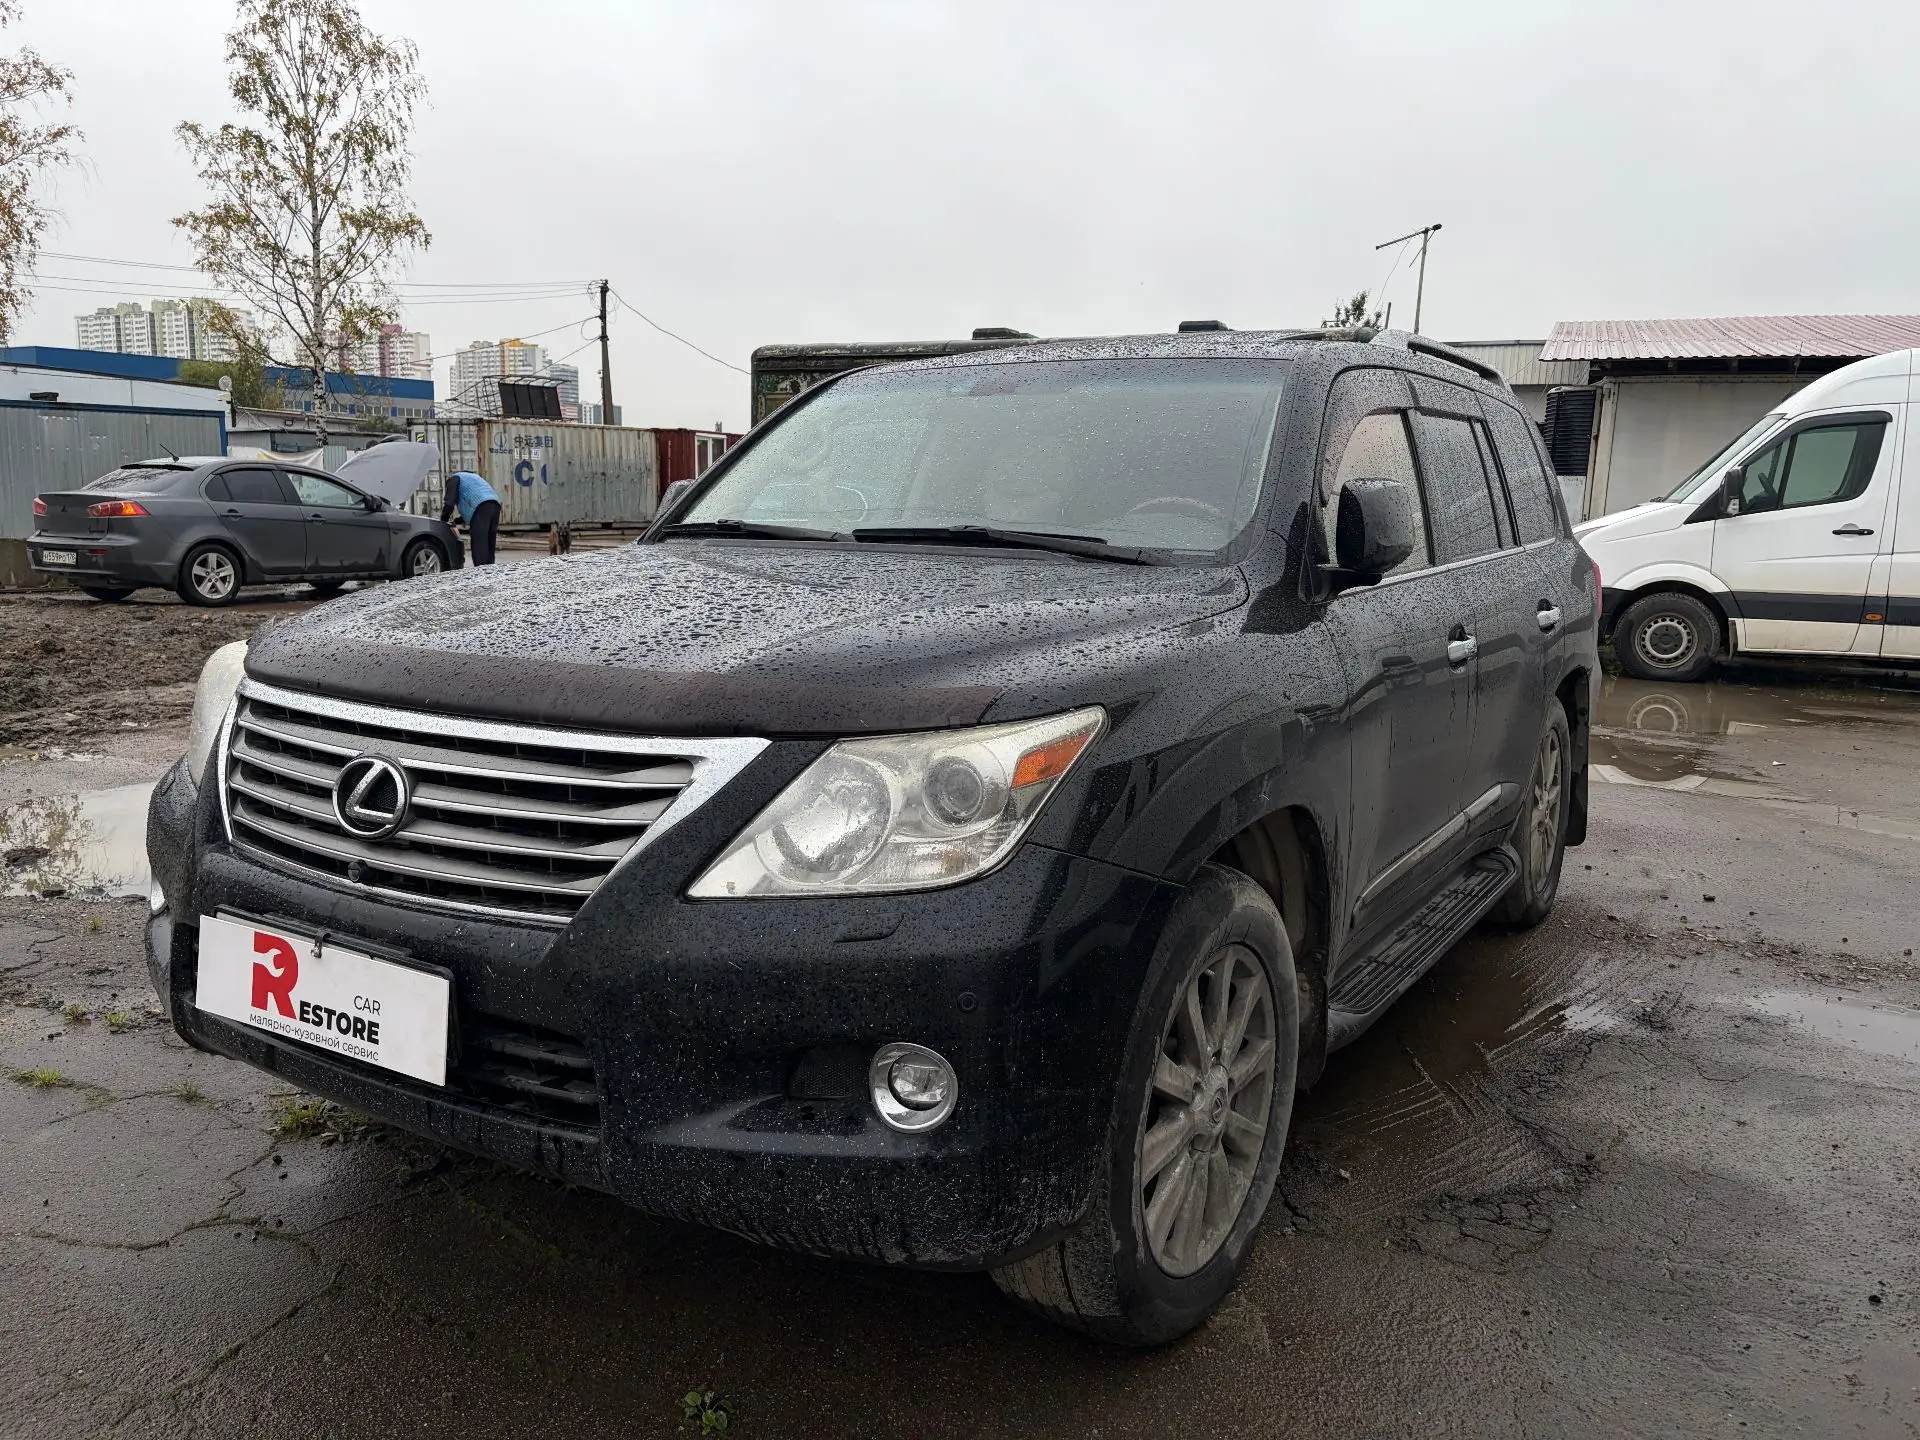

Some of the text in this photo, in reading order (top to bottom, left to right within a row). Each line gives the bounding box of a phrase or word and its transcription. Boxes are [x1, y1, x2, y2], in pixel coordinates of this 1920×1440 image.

[353, 995, 381, 1016] CAR
[250, 1013, 379, 1061] малярно-кузовной сервис
